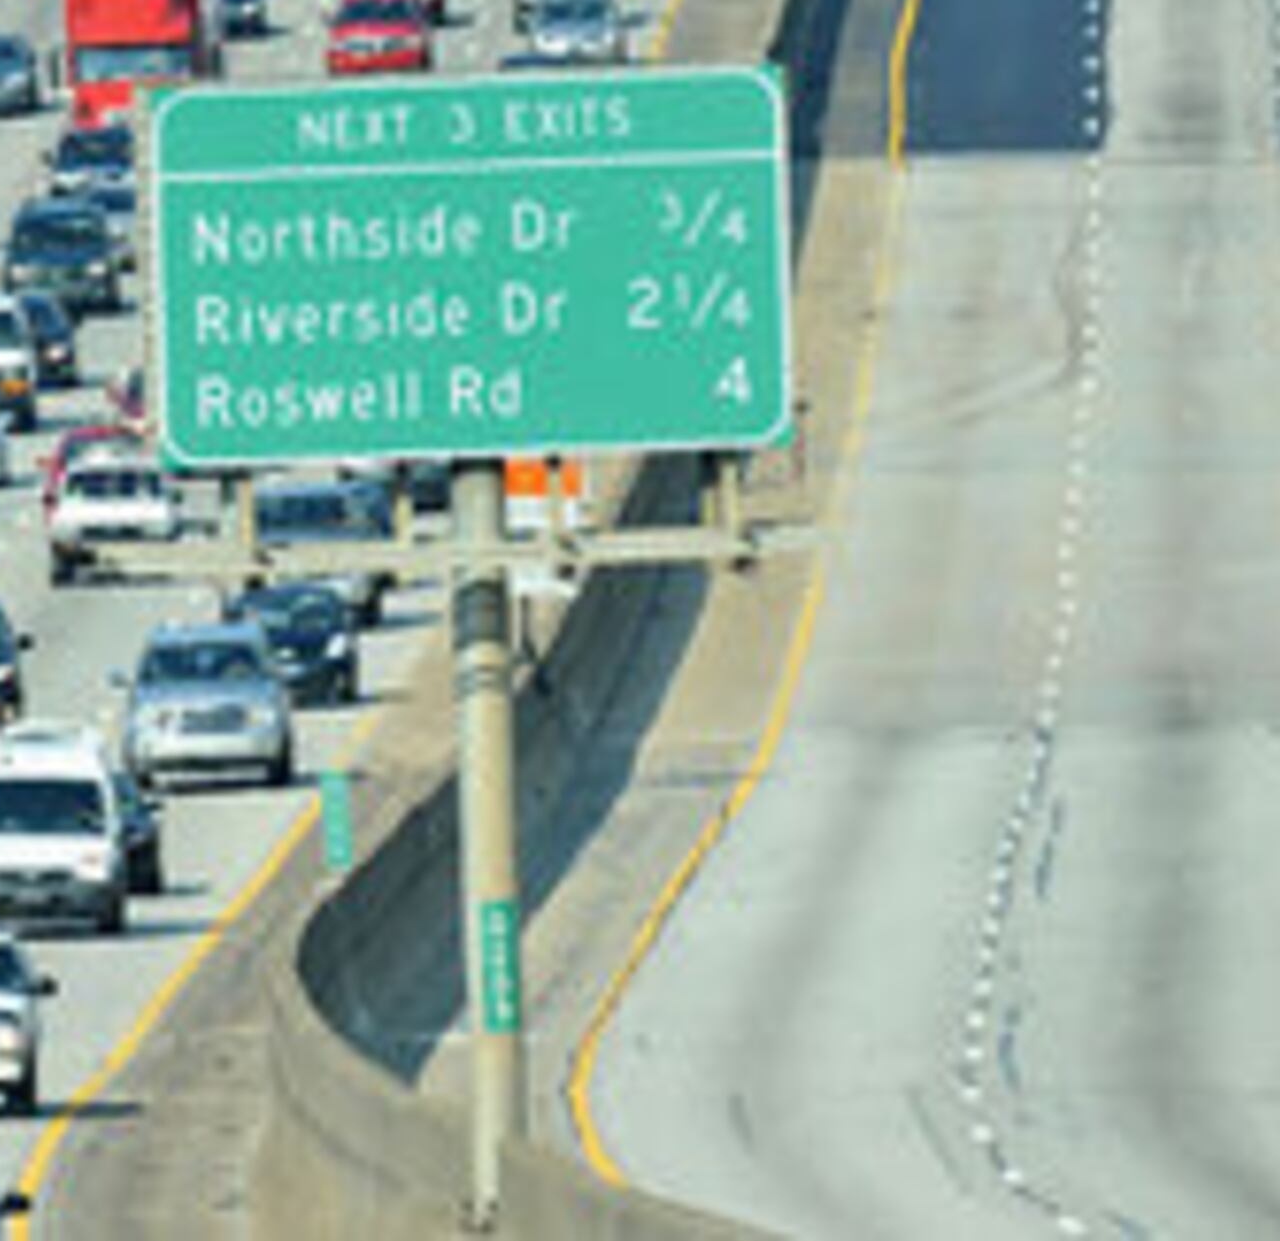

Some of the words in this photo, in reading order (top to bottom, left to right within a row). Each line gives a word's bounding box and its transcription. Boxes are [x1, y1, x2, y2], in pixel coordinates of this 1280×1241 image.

[297, 106, 411, 151] NEXT
[449, 102, 477, 145] 3
[504, 96, 632, 139] EXITS
[193, 204, 481, 266] Northside
[510, 199, 576, 253] Dr
[657, 189, 748, 247] 3/4
[195, 289, 471, 347] Riverside
[502, 281, 568, 337] Dr
[196, 369, 421, 430] Roswell
[449, 364, 523, 417] Rd
[713, 354, 752, 405] 4
